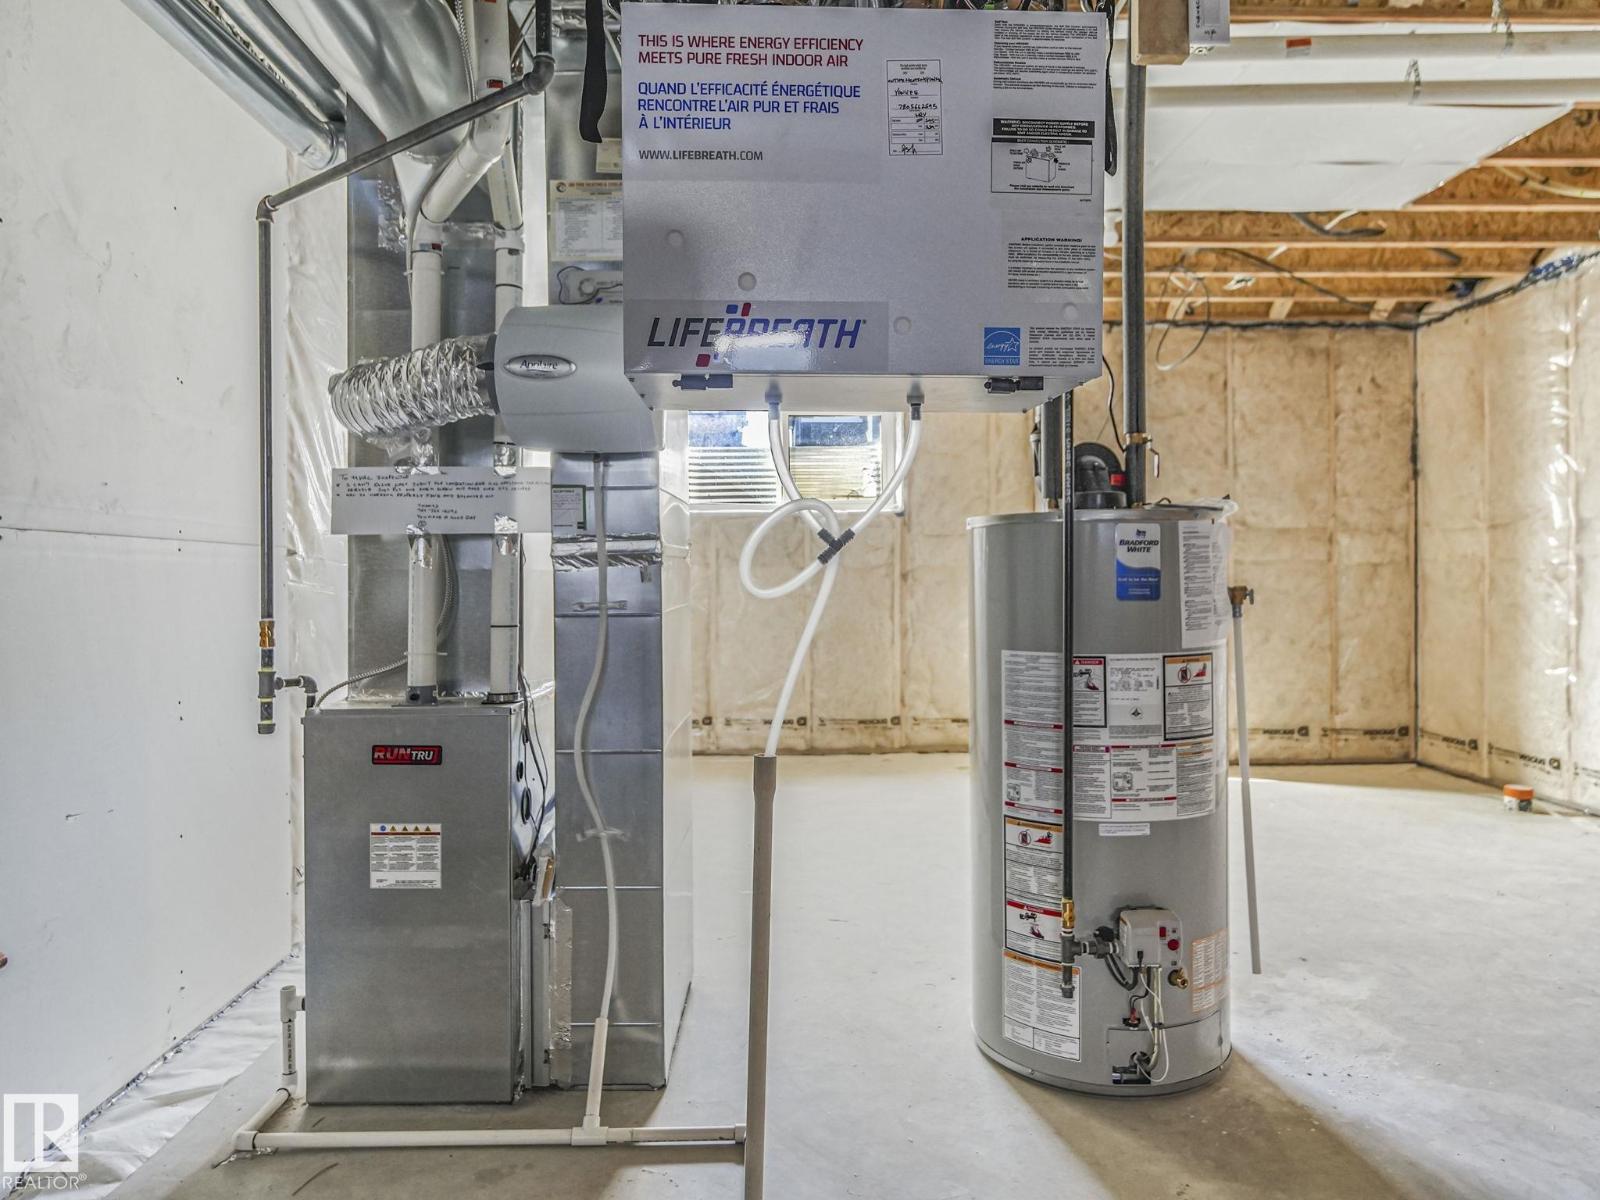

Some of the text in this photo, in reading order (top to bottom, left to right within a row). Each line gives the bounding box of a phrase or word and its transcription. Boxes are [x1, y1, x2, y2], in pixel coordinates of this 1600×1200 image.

[638, 34, 864, 51] THIS IS WHERE ENERGY EFFICIENCY
[638, 51, 848, 67] MEETS PURE FRESH INDOOR AIR
[638, 81, 861, 98] QUAND L'EFFICACITÉ ÉNERGÉTIQUE
[638, 99, 839, 114] RENCONTRE L'AIR PUR ET FRAIS
[638, 114, 731, 130] À L'INTÉRIEUR
[638, 150, 763, 161] WWW.LIFEBREATH.COM
